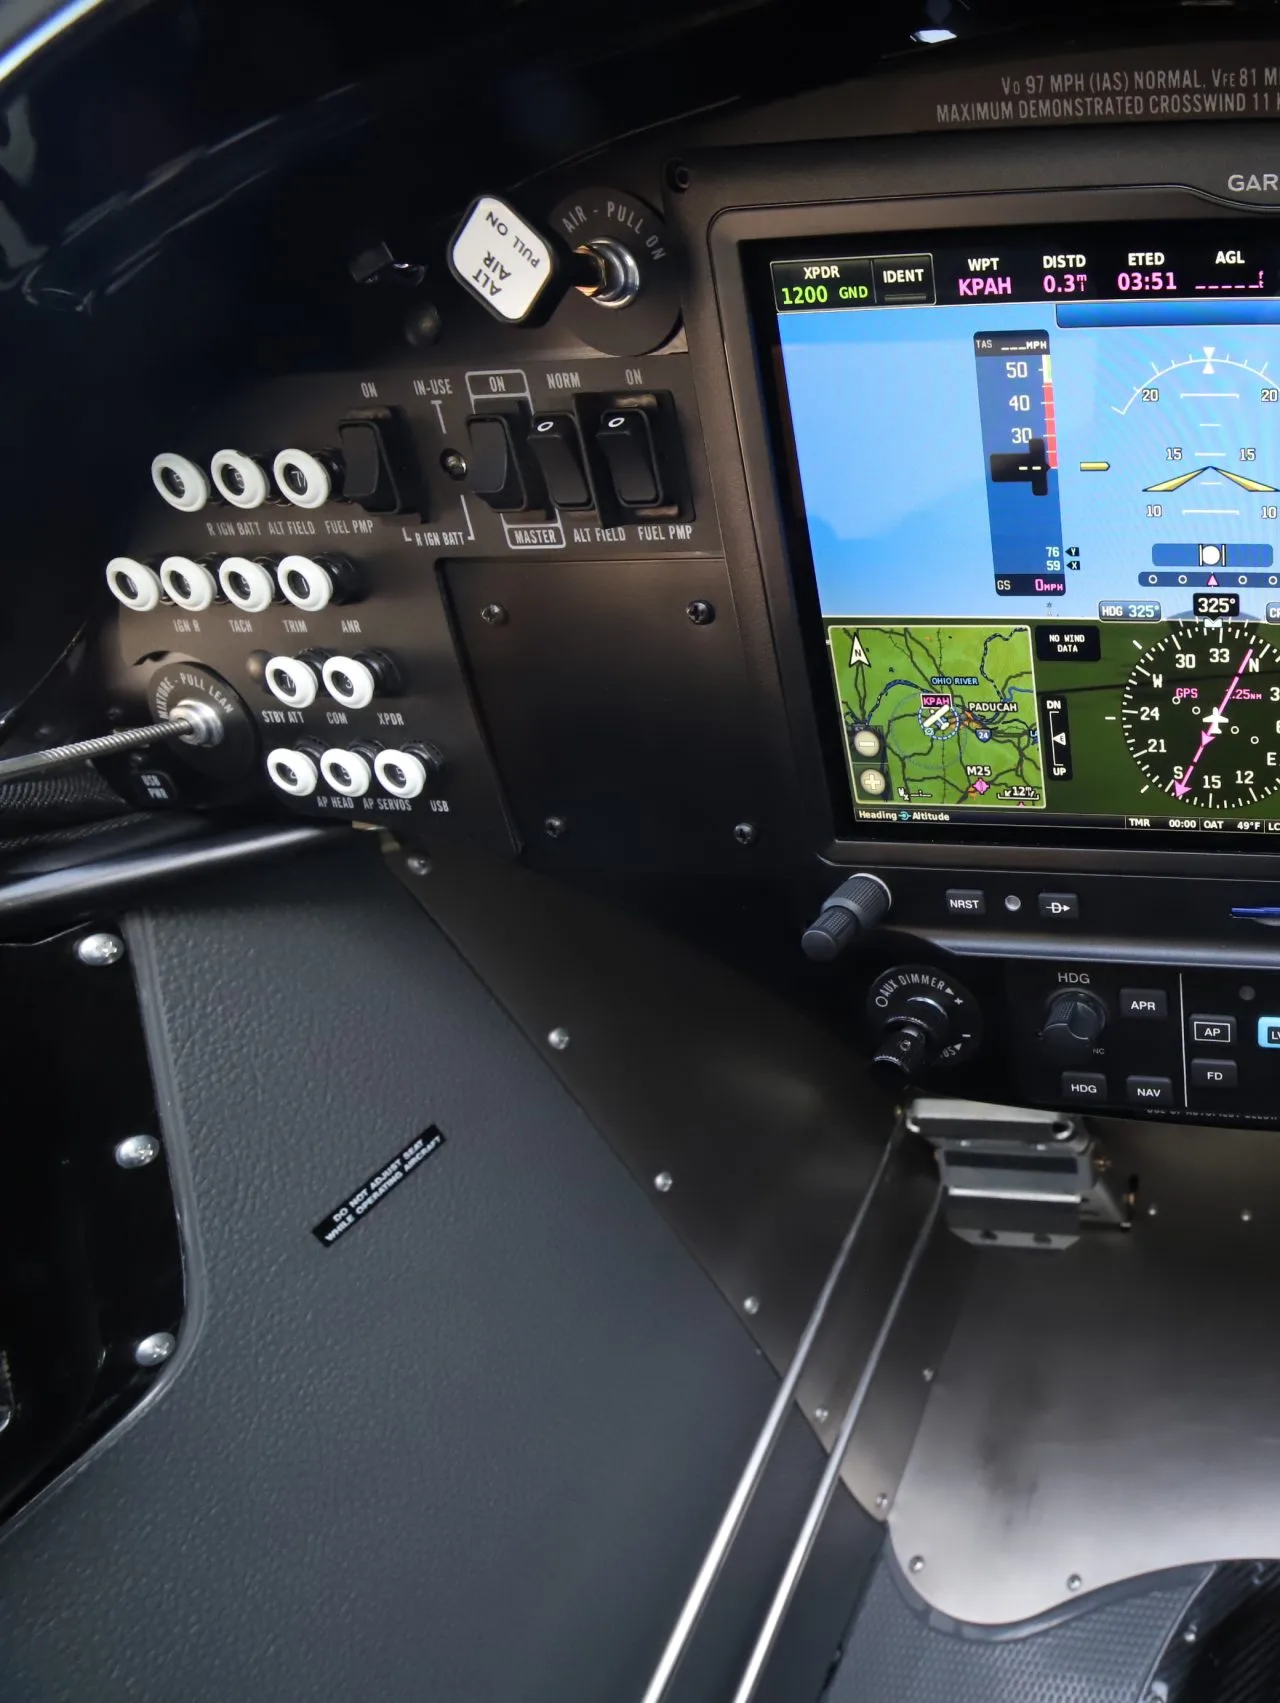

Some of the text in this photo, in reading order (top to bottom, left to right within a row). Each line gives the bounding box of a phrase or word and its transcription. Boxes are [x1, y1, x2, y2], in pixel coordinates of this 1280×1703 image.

[1026, 75, 1044, 94] 97
[1050, 73, 1084, 94] MPH
[1090, 71, 1128, 93] (IAS)
[1239, 68, 1257, 87] 81
[936, 101, 1014, 123] MAXIMUM
[1019, 96, 1144, 118] DEMONSTRATED
[1150, 93, 1246, 114] CROSSWIND
[1252, 93, 1269, 112] 11
[562, 201, 667, 261] AIR PULL ON
[486, 211, 541, 268] PULL ON
[1043, 254, 1086, 269] DISTD
[1128, 252, 1165, 267] ETED
[1215, 250, 1245, 264] AGL
[482, 251, 512, 281] AIR
[804, 265, 840, 280] XPDR
[968, 258, 999, 272] WPT
[472, 268, 502, 297] ALT
[883, 268, 924, 284] IDENT
[1117, 272, 1177, 291] 03:51
[958, 277, 1012, 296] KPAH
[781, 285, 868, 305] 1200 GND
[413, 379, 453, 396] IN-USE
[488, 376, 506, 392] ON
[546, 372, 581, 389] NORM
[513, 528, 556, 544] MASTER
[574, 526, 626, 543] ALT FIELD
[638, 525, 693, 541] FUEL PMP
[1101, 606, 1123, 617] HDG
[228, 619, 252, 632] TACH
[283, 619, 308, 632] TRIM
[341, 619, 361, 633] ANR
[1049, 634, 1085, 643] NO WIND
[1058, 644, 1078, 653] DATA
[180, 672, 234, 713] PULL LEAN
[923, 697, 949, 705] KPAH
[969, 702, 1017, 711] PADUCAH
[262, 710, 304, 724] STBY ATT
[327, 711, 348, 725] COM
[377, 712, 404, 726] XPDR
[966, 766, 991, 775] M25
[429, 800, 449, 812] USB
[859, 811, 950, 821] Heading Altitude
[949, 899, 979, 910] NRST
[880, 973, 945, 997] AUX DIMMER
[1058, 972, 1090, 985] HDG
[1130, 1001, 1156, 1011] APR
[1070, 1084, 1097, 1094] HDG
[1137, 1087, 1161, 1098] NAV
[325, 1135, 441, 1241] WHILE OPERATING AIRCRAFT
[332, 1139, 424, 1223] DO NOT ADJUST SEAT
